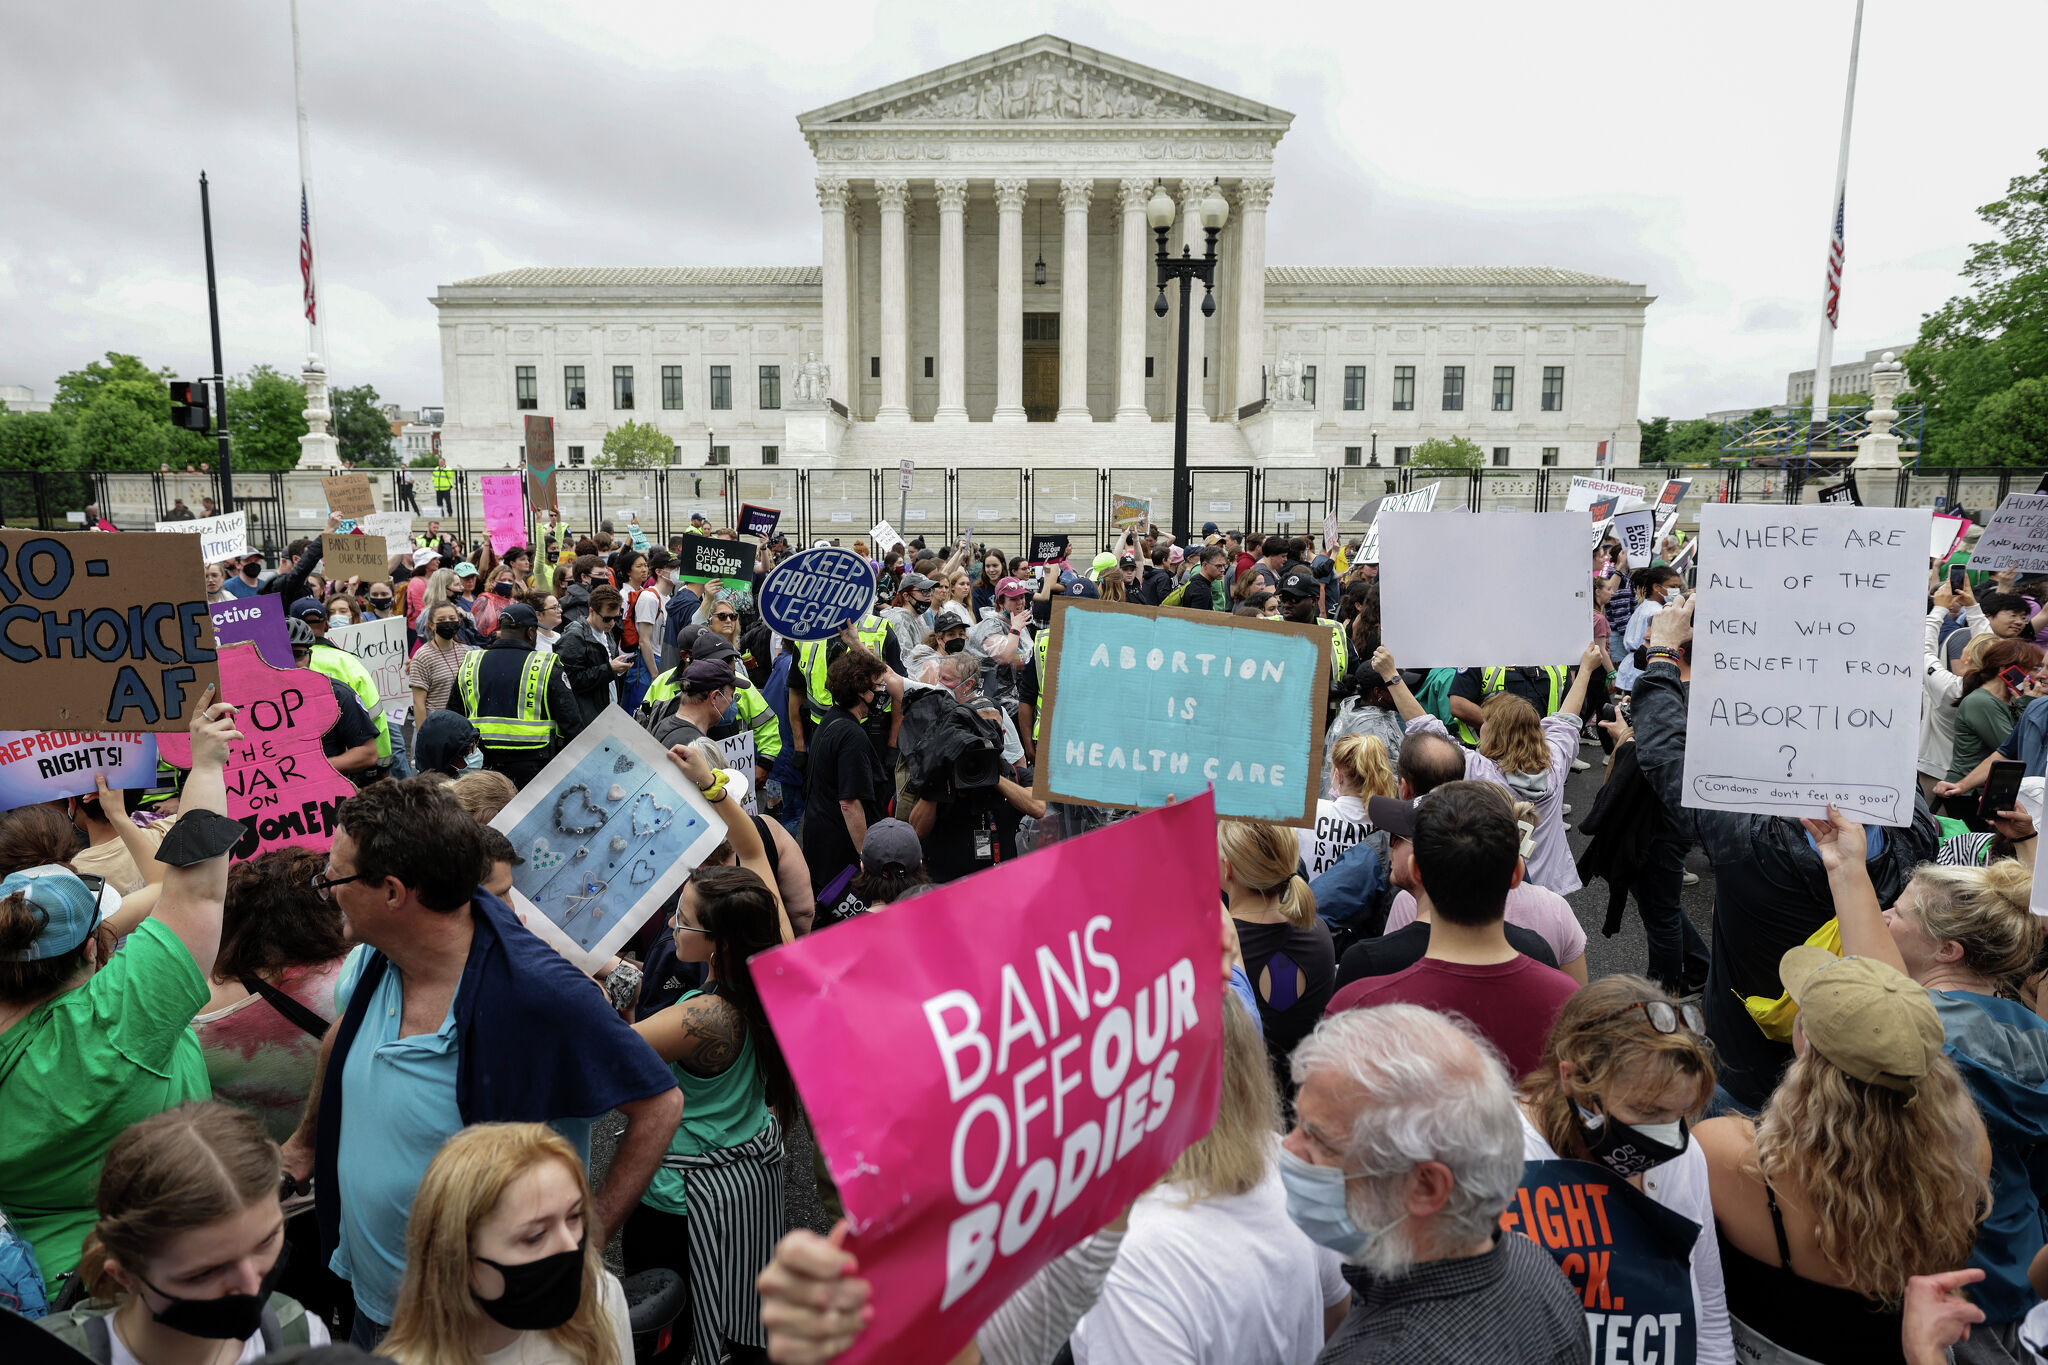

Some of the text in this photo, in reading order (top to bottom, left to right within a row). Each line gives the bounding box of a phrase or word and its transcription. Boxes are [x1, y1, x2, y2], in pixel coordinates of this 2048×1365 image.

[1573, 478, 1644, 497] WE REMEMBER
[215, 517, 244, 534] Alito
[1717, 526, 1906, 549] WHERE ARE
[328, 538, 350, 551] BANS
[697, 545, 725, 558] BANS
[1356, 533, 1379, 562] HE
[1626, 526, 1639, 557] BODY
[1634, 524, 1646, 557] EVERY
[1987, 538, 2012, 547] AND
[339, 553, 383, 565] OUR BODIES
[695, 553, 742, 568] OFF OUR
[695, 561, 737, 575] BODIES
[799, 551, 866, 581] KEEP
[1972, 556, 1992, 564] are
[768, 568, 870, 611] ABORTION
[1709, 573, 1891, 589] ALL OF THE
[212, 606, 262, 626] ctive
[770, 594, 848, 630] LEGAL
[0, 601, 217, 664] CHOICE
[1709, 619, 1855, 636] MEN WHO
[352, 623, 405, 673] body
[1090, 642, 1285, 683] ABORTION
[466, 662, 474, 695] USCP
[1714, 652, 1911, 678] BENEFIT FROM
[106, 665, 196, 724] AF
[1167, 697, 1198, 720] IS
[229, 689, 304, 732] OP
[1709, 698, 1893, 730] ABORTION
[724, 735, 747, 753] MY
[37, 747, 122, 780] RIGHTS!
[1065, 739, 1285, 786] HEALTH CARE
[1778, 745, 1797, 778] ?
[249, 793, 279, 810] ON
[1770, 788, 1799, 799] don't
[1807, 790, 1829, 801] feel
[1836, 792, 1849, 801] as
[229, 796, 347, 863] WOMEN
[1315, 841, 1354, 859] IS NE
[922, 915, 1120, 1102] BANS
[951, 957, 1199, 1204] OFF OUR
[940, 1049, 1179, 1312] BODIES
